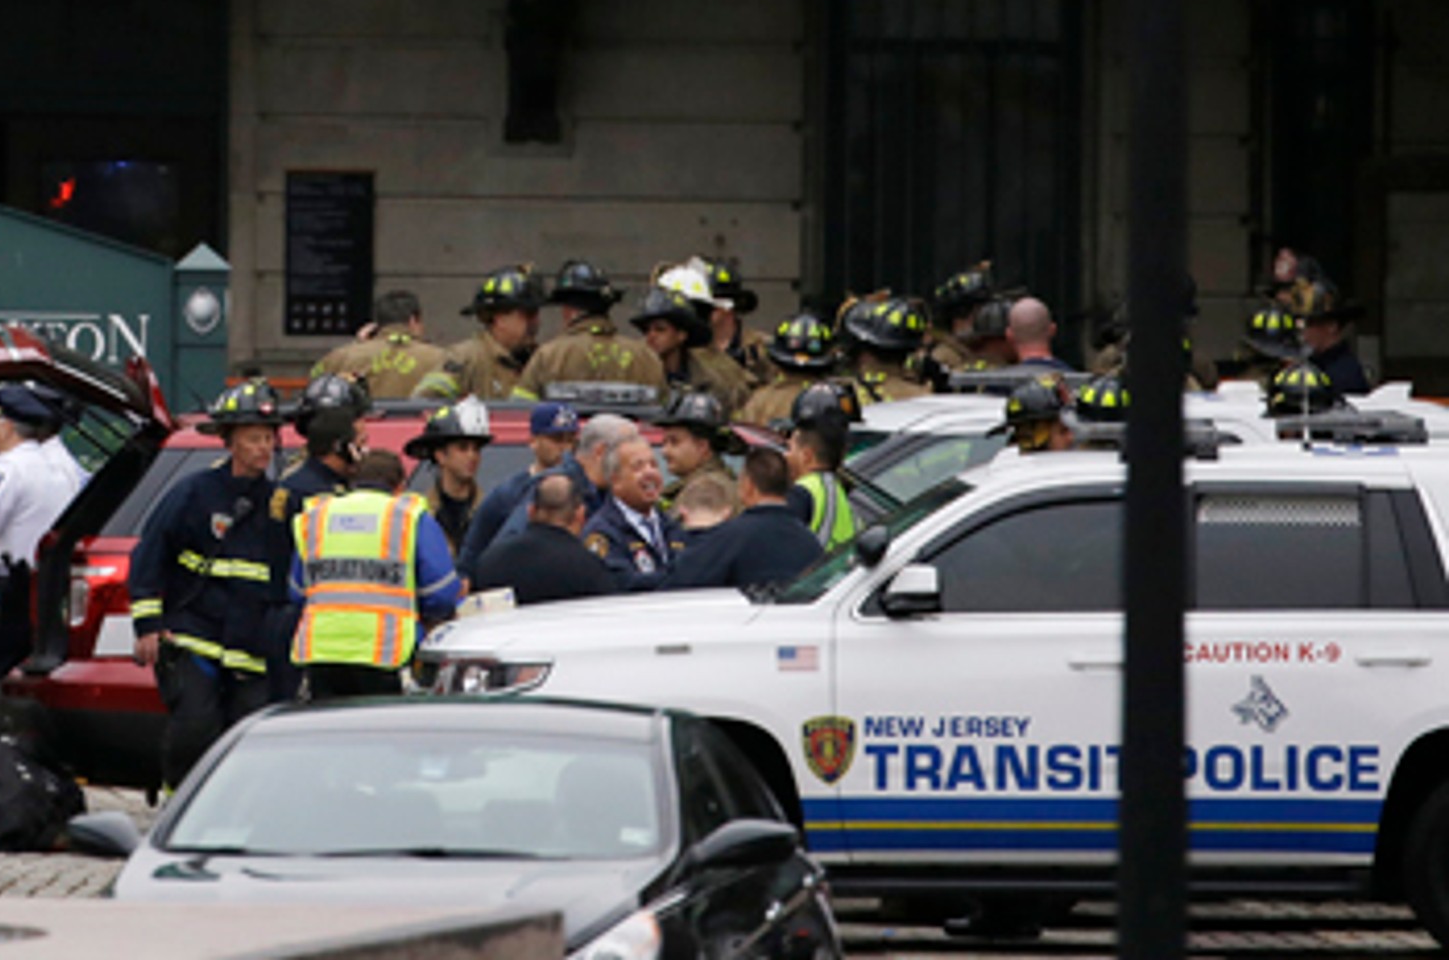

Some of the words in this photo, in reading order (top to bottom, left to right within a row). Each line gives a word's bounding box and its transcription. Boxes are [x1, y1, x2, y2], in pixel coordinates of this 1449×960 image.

[1297, 642, 1343, 663] K-9
[863, 715, 925, 738] NEW
[931, 715, 1032, 738] JERSEY
